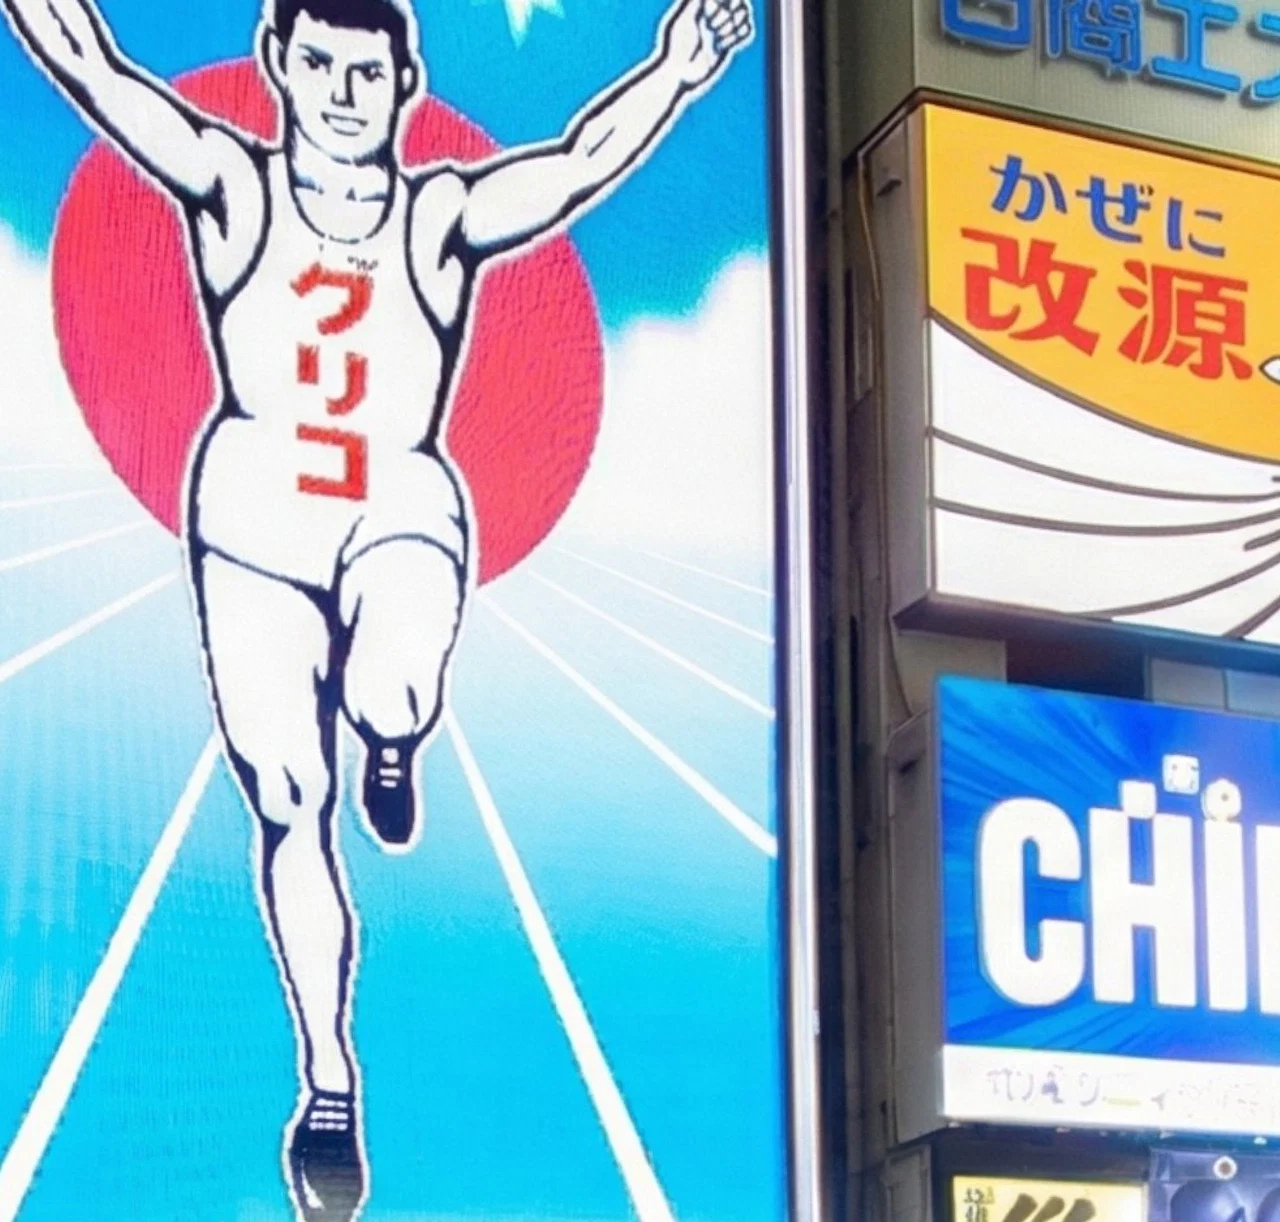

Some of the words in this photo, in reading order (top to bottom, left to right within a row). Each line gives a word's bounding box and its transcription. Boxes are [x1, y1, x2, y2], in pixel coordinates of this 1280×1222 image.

[988, 152, 1227, 259] かぜに
[290, 257, 377, 503] グリコ
[959, 226, 1255, 382] 改源
